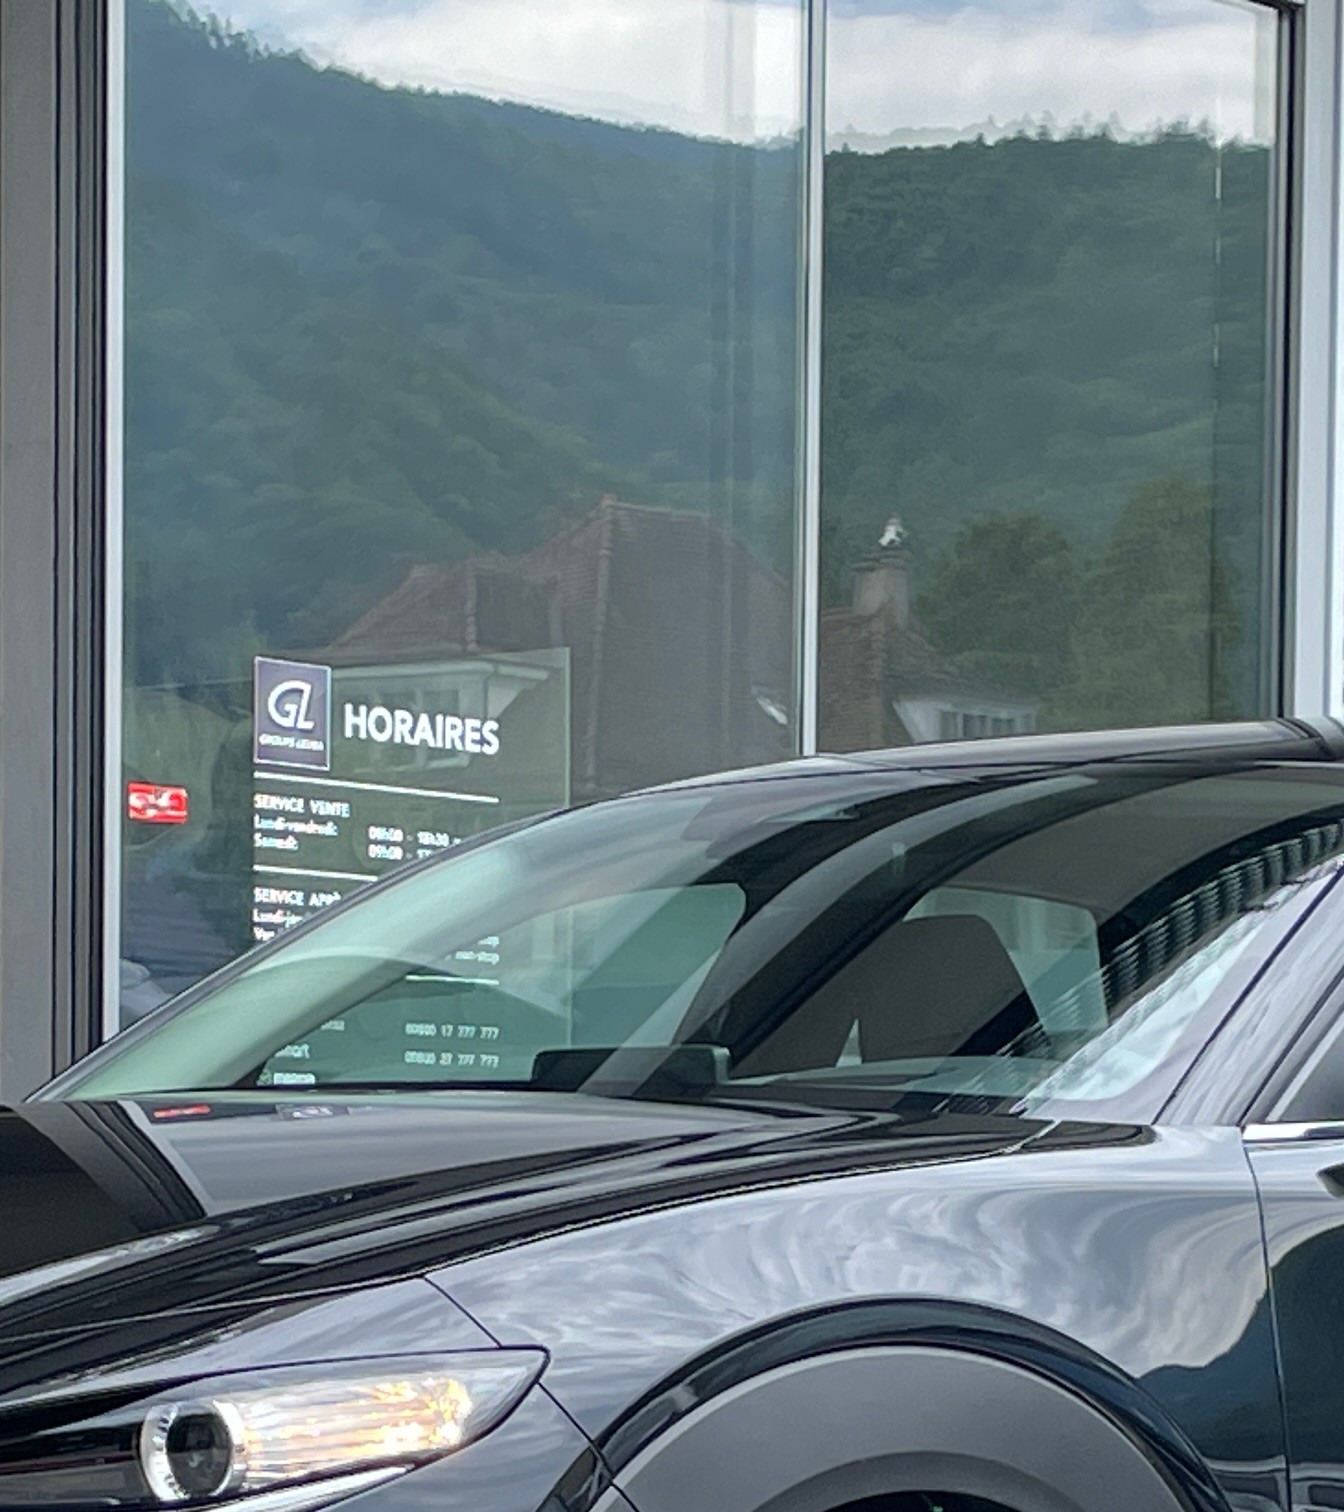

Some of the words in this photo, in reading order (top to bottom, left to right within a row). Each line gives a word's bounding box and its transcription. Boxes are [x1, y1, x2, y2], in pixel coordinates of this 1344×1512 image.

[268, 680, 315, 729] GL
[344, 703, 500, 755] HORAIRES
[253, 792, 305, 813] SERVICE
[309, 798, 351, 818] VENTE
[253, 886, 304, 906] SERVICE
